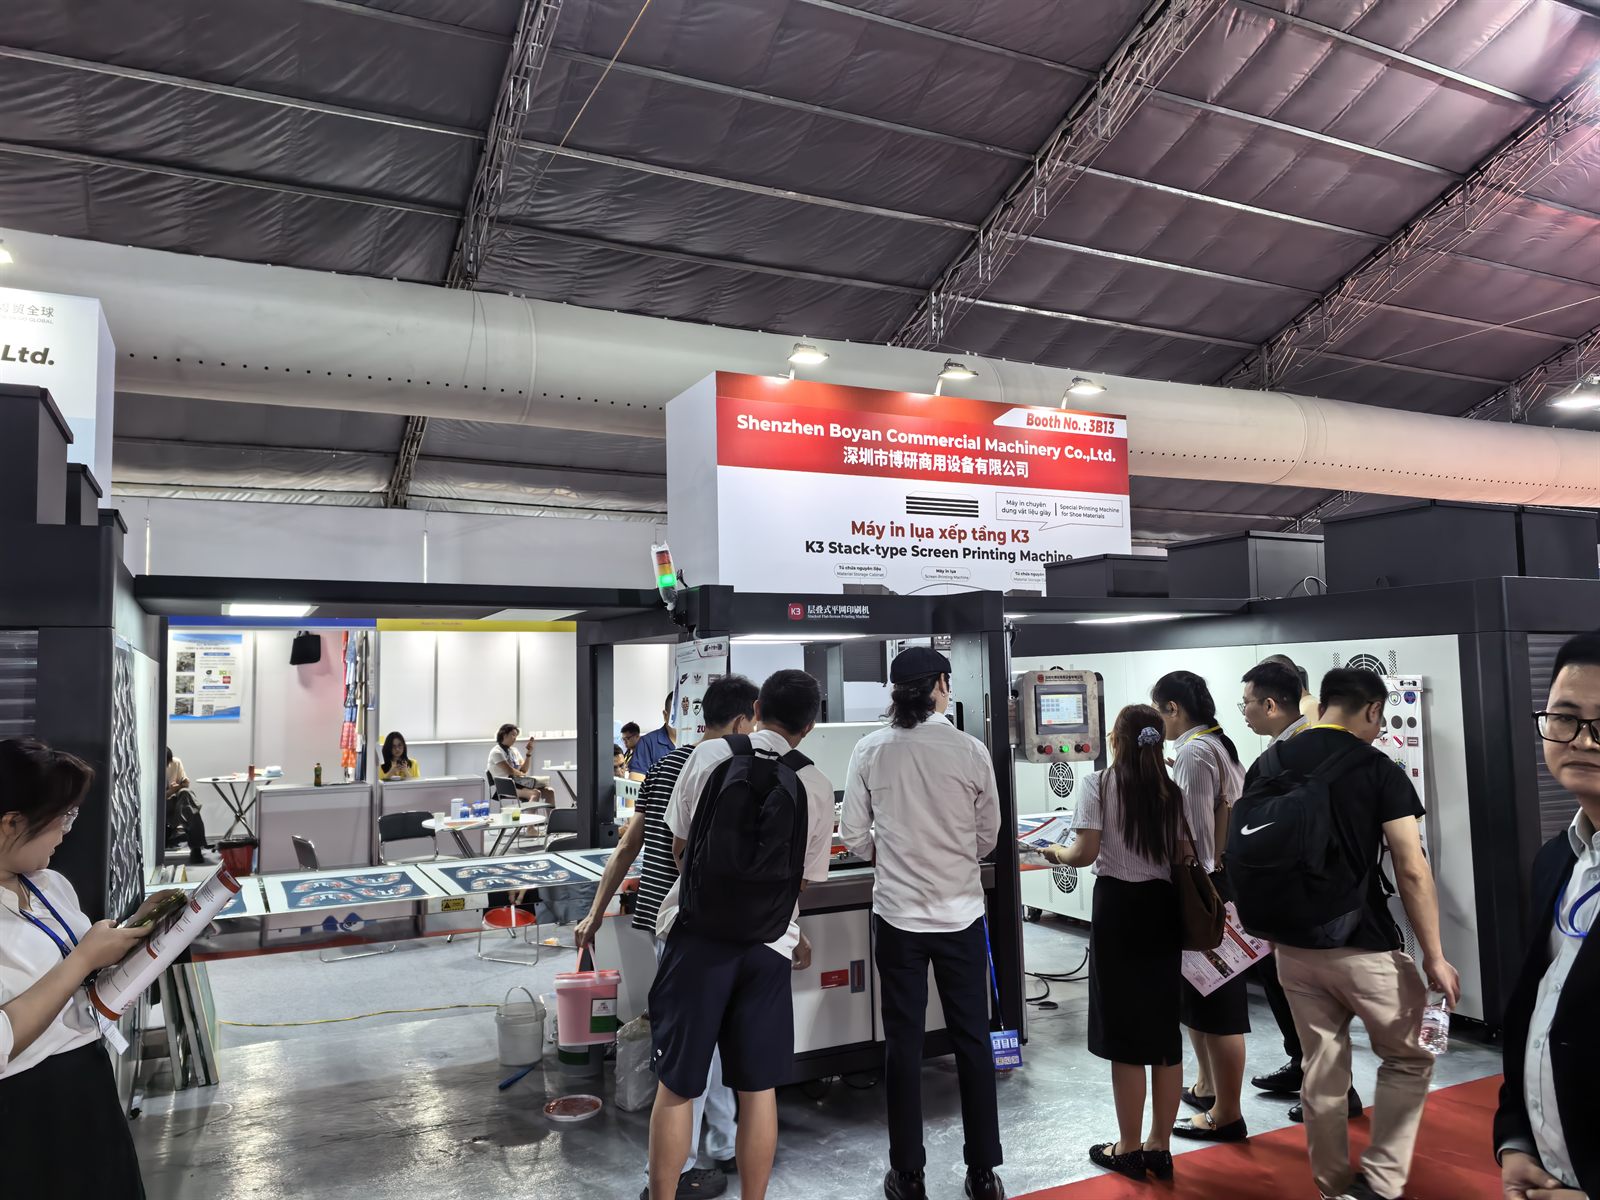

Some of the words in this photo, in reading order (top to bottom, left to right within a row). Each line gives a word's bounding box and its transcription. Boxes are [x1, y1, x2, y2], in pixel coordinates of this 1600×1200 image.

[1026, 412, 1061, 429] Booth
[1088, 418, 1115, 435] 3B13
[736, 414, 825, 437] Shenzhen
[829, 423, 882, 443] Boyan
[886, 429, 981, 450] Commercial
[985, 437, 1061, 460] Machinery
[1064, 445, 1117, 463] Co.,Ltd.
[843, 446, 1029, 478] 深圳市博研商用设备有限公司
[1006, 499, 1018, 507] Máy
[1026, 500, 1047, 508] chuyên
[1078, 505, 1098, 513] Printing
[851, 520, 885, 540] Máy
[890, 522, 905, 538] in
[910, 523, 934, 543] lụa
[939, 523, 968, 543] xếp
[972, 525, 1006, 545] tầng
[1011, 529, 1030, 544] K3
[805, 540, 824, 554] K3
[828, 541, 908, 559] Stack-type
[911, 545, 958, 559] Screen
[962, 546, 1016, 563] Printing
[1020, 549, 1073, 562] Machine
